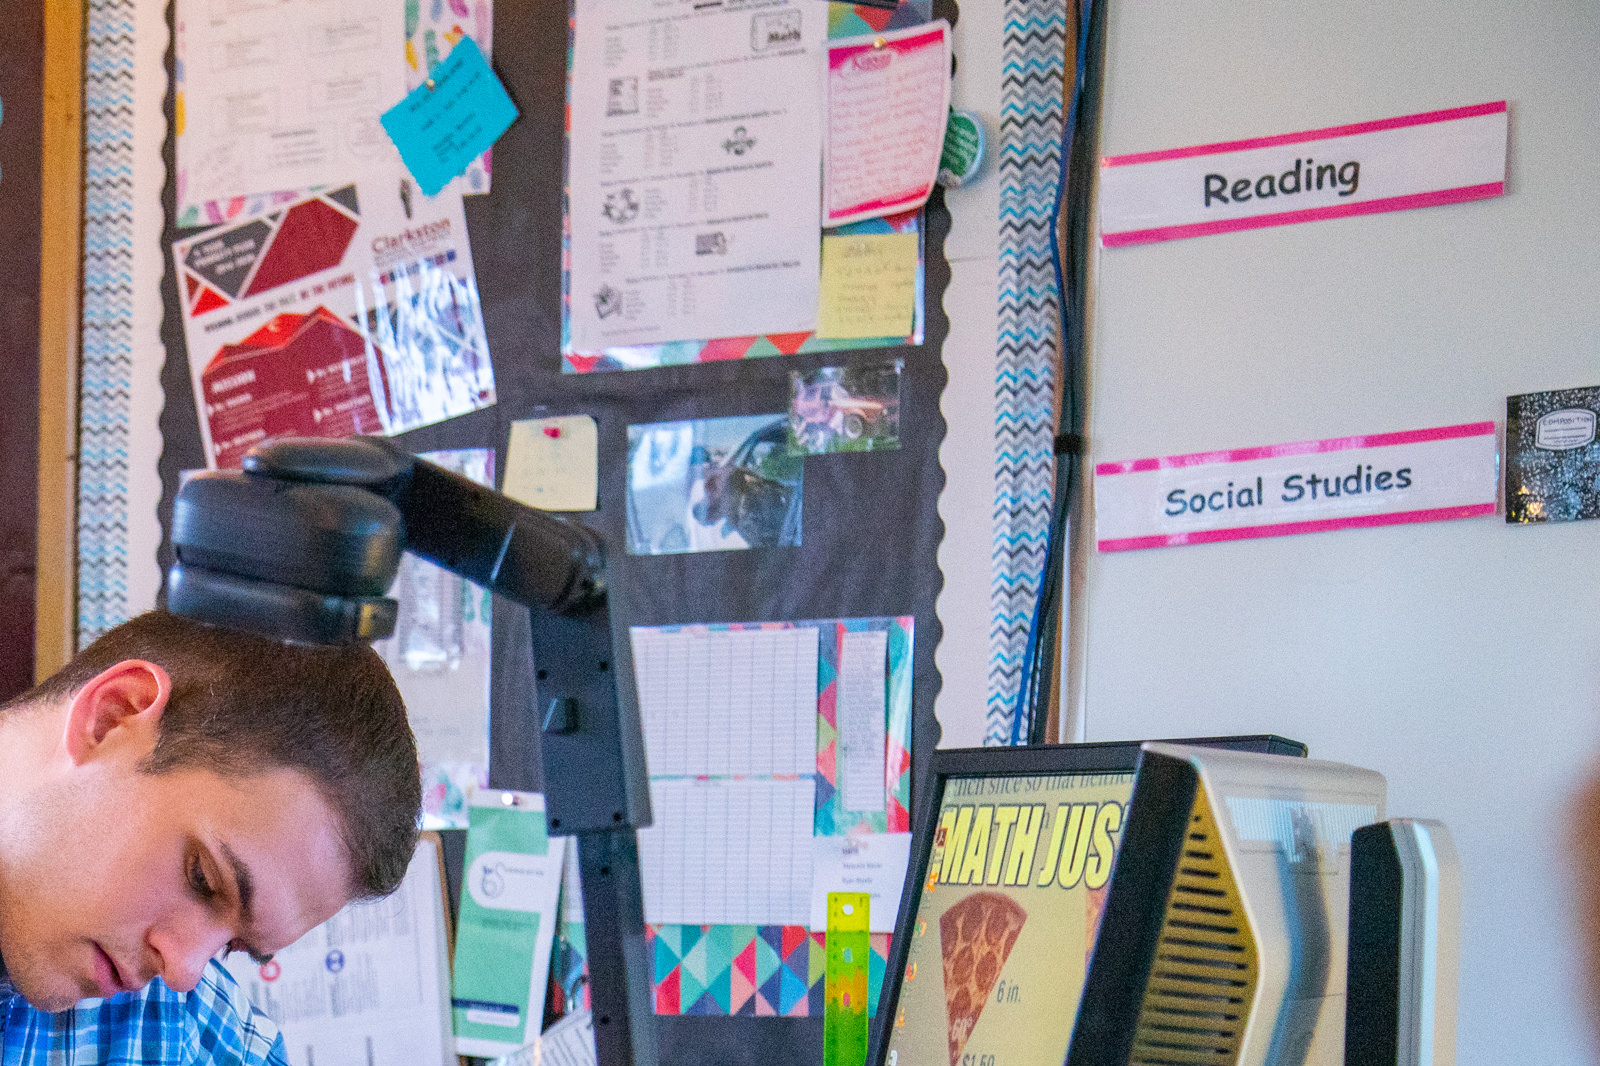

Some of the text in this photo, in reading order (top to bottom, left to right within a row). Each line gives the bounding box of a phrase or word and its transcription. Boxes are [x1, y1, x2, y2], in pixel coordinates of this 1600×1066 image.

[1203, 158, 1360, 208] Reading
[1163, 463, 1414, 517] Social Studies
[933, 802, 1046, 887] MATH
[1037, 800, 1130, 890] JUS
[997, 979, 1022, 1003] 6 in.
